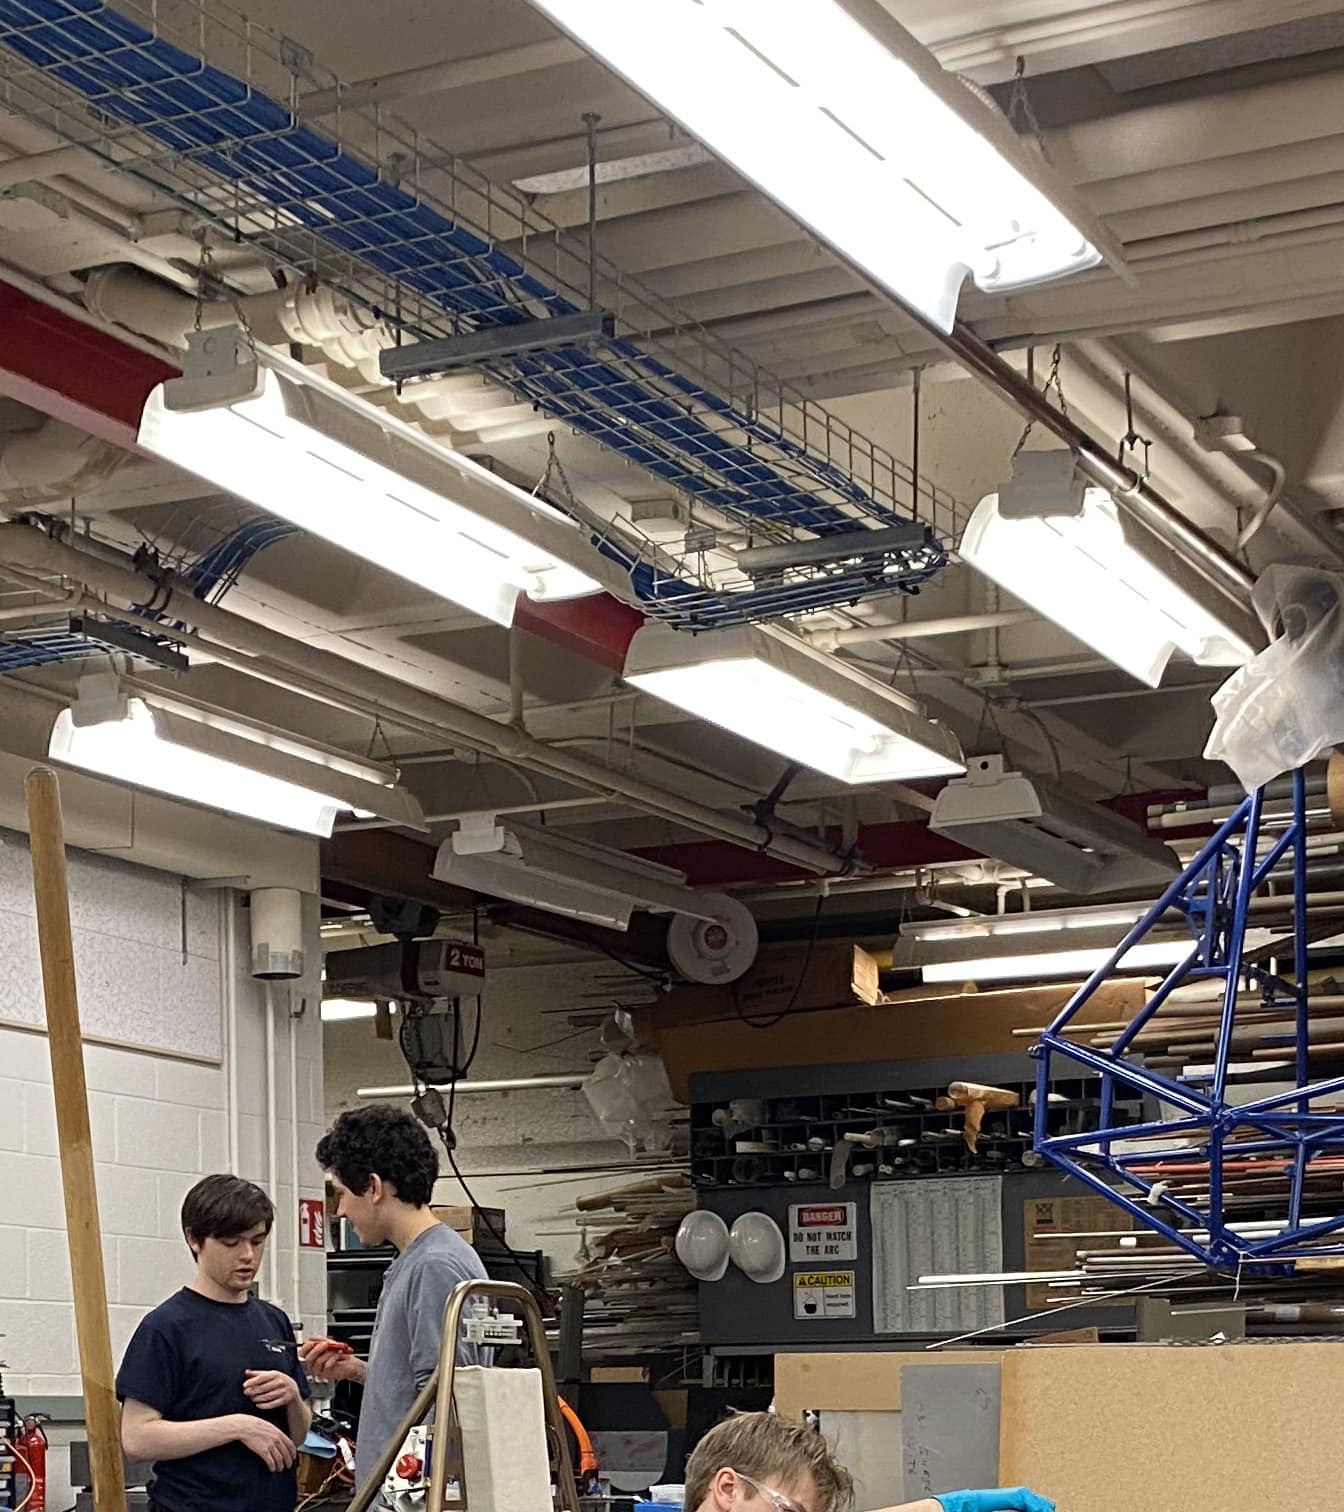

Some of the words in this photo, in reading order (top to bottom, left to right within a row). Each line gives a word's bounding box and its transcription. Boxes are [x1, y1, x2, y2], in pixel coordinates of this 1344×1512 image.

[449, 949, 460, 966] 2
[463, 954, 484, 970] TON
[801, 1211, 843, 1222] DANGER
[794, 1232, 803, 1242] DO
[807, 1232, 821, 1242] NOT
[827, 1231, 852, 1241] WATCH
[806, 1245, 820, 1255] THE
[824, 1245, 840, 1255] ARC
[807, 1275, 850, 1285] CAUTION
